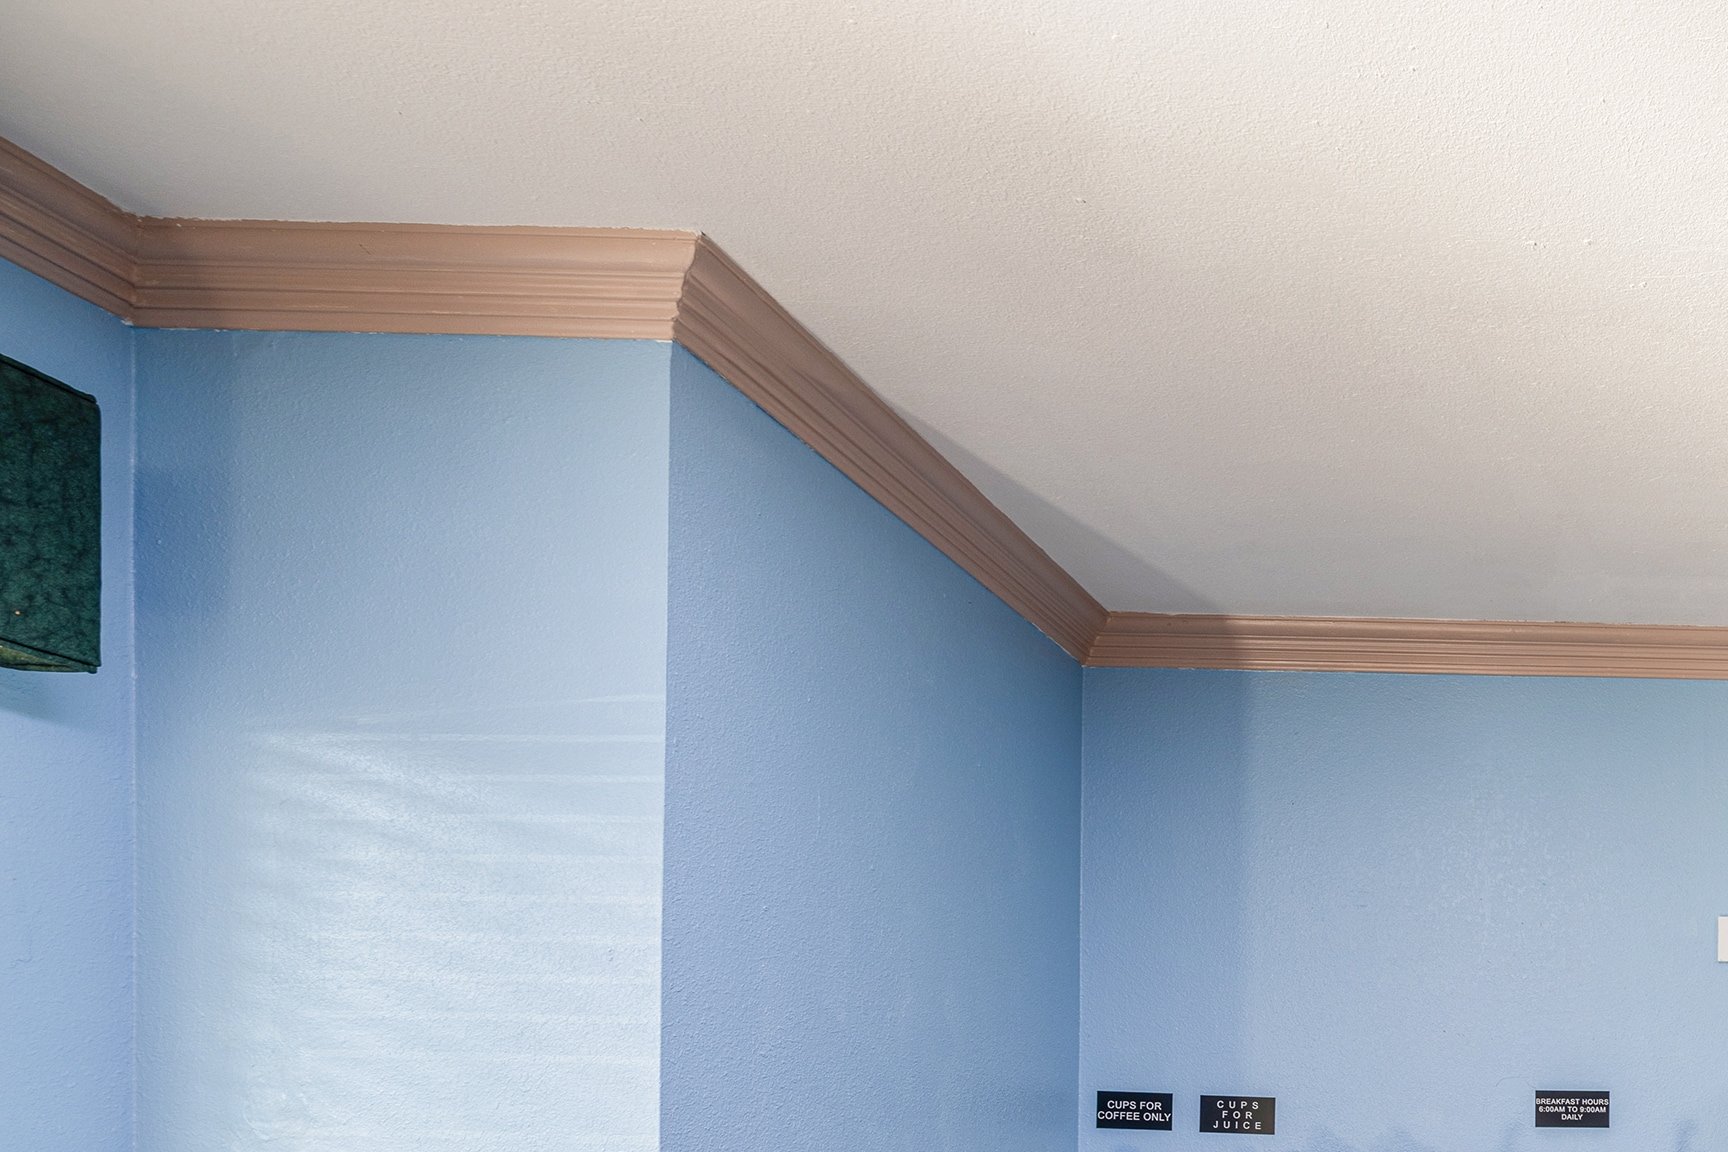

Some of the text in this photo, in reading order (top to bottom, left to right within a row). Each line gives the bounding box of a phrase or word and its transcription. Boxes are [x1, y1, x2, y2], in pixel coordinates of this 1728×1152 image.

[1107, 1100, 1162, 1111] CUPS FOR
[1216, 1100, 1259, 1110] CUPS
[1582, 1098, 1609, 1106] HOURS
[1097, 1110, 1172, 1122] COFFEE ONLY
[1221, 1110, 1253, 1119] FOR
[1213, 1121, 1262, 1130] JUICE
